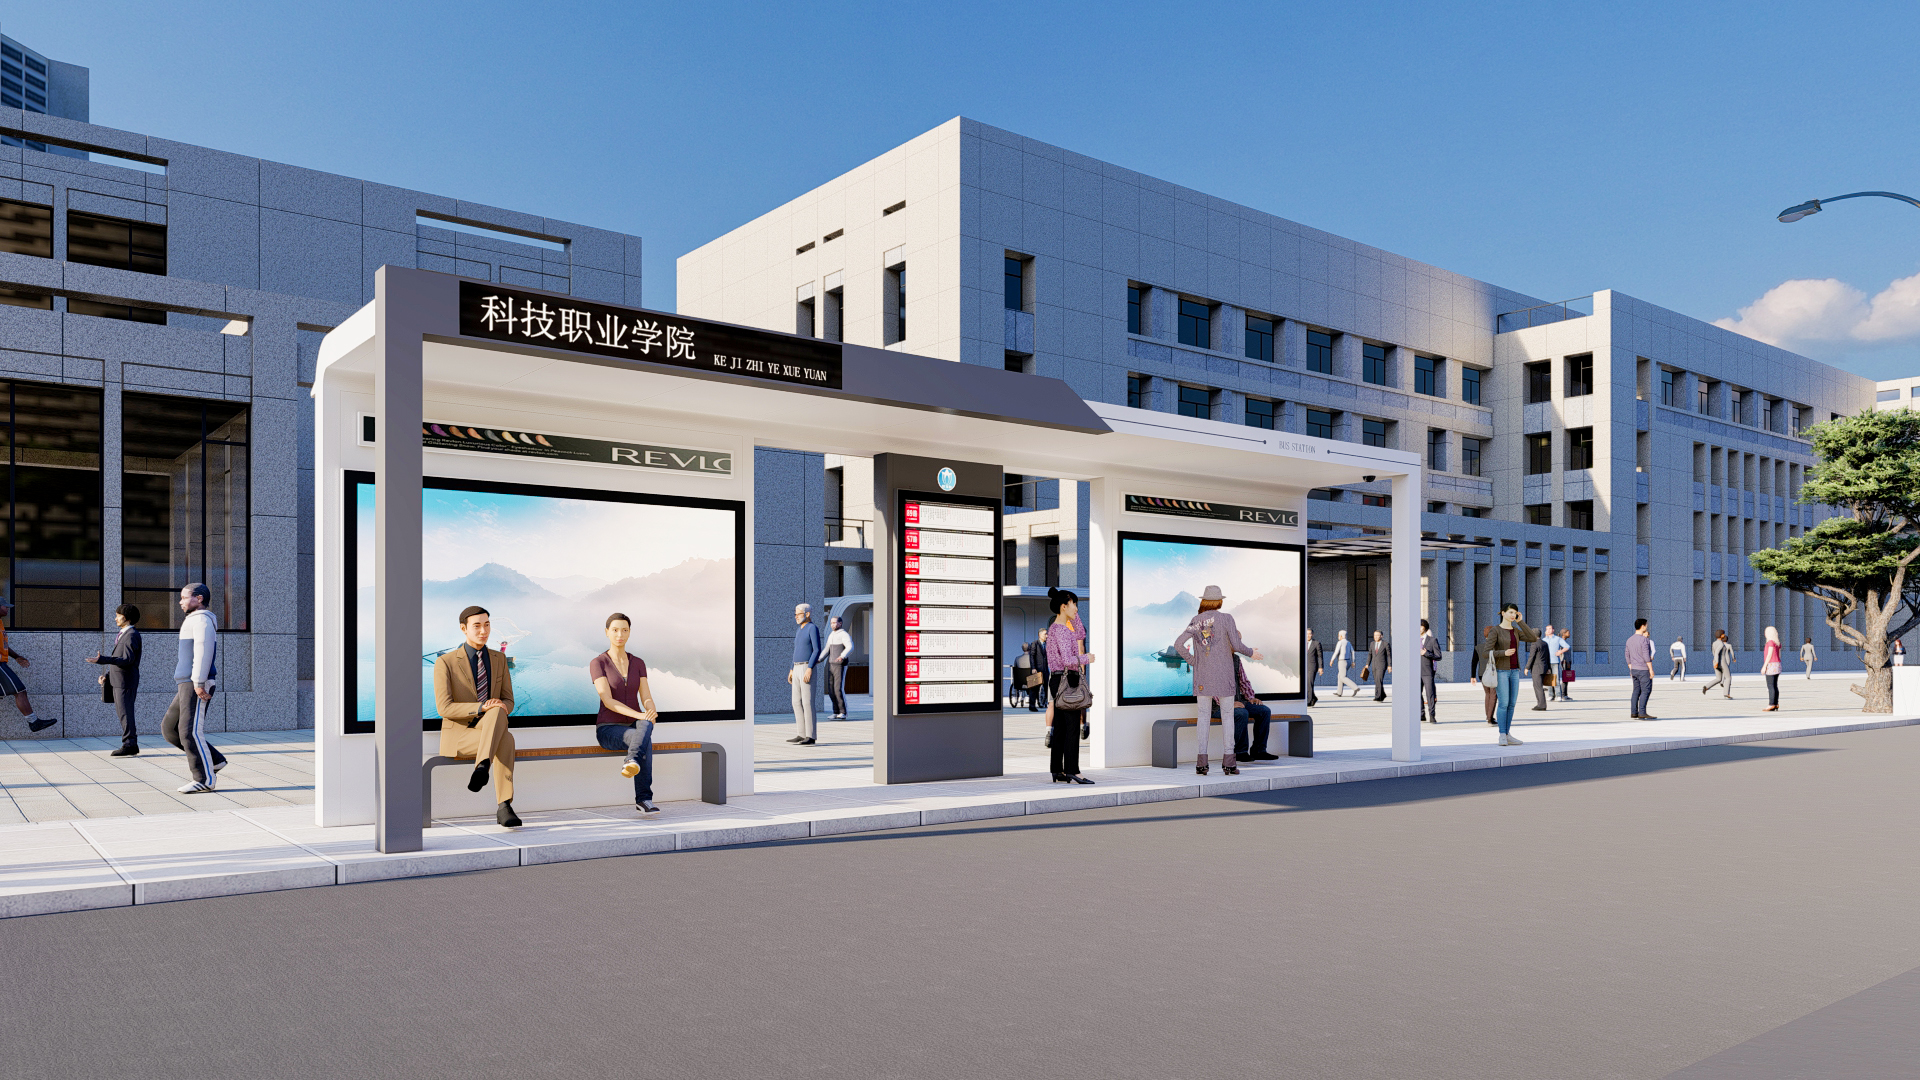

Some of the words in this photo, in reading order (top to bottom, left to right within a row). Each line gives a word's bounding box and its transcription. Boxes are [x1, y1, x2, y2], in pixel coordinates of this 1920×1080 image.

[480, 294, 696, 360] 科技职业学院
[713, 354, 727, 366] KE
[729, 356, 742, 370] JI
[745, 359, 764, 372] ZHI
[767, 362, 780, 374] YE
[782, 364, 800, 378] XUE
[803, 367, 827, 381] YUAN
[1278, 440, 1290, 450] BUS
[1291, 442, 1316, 454] STATION
